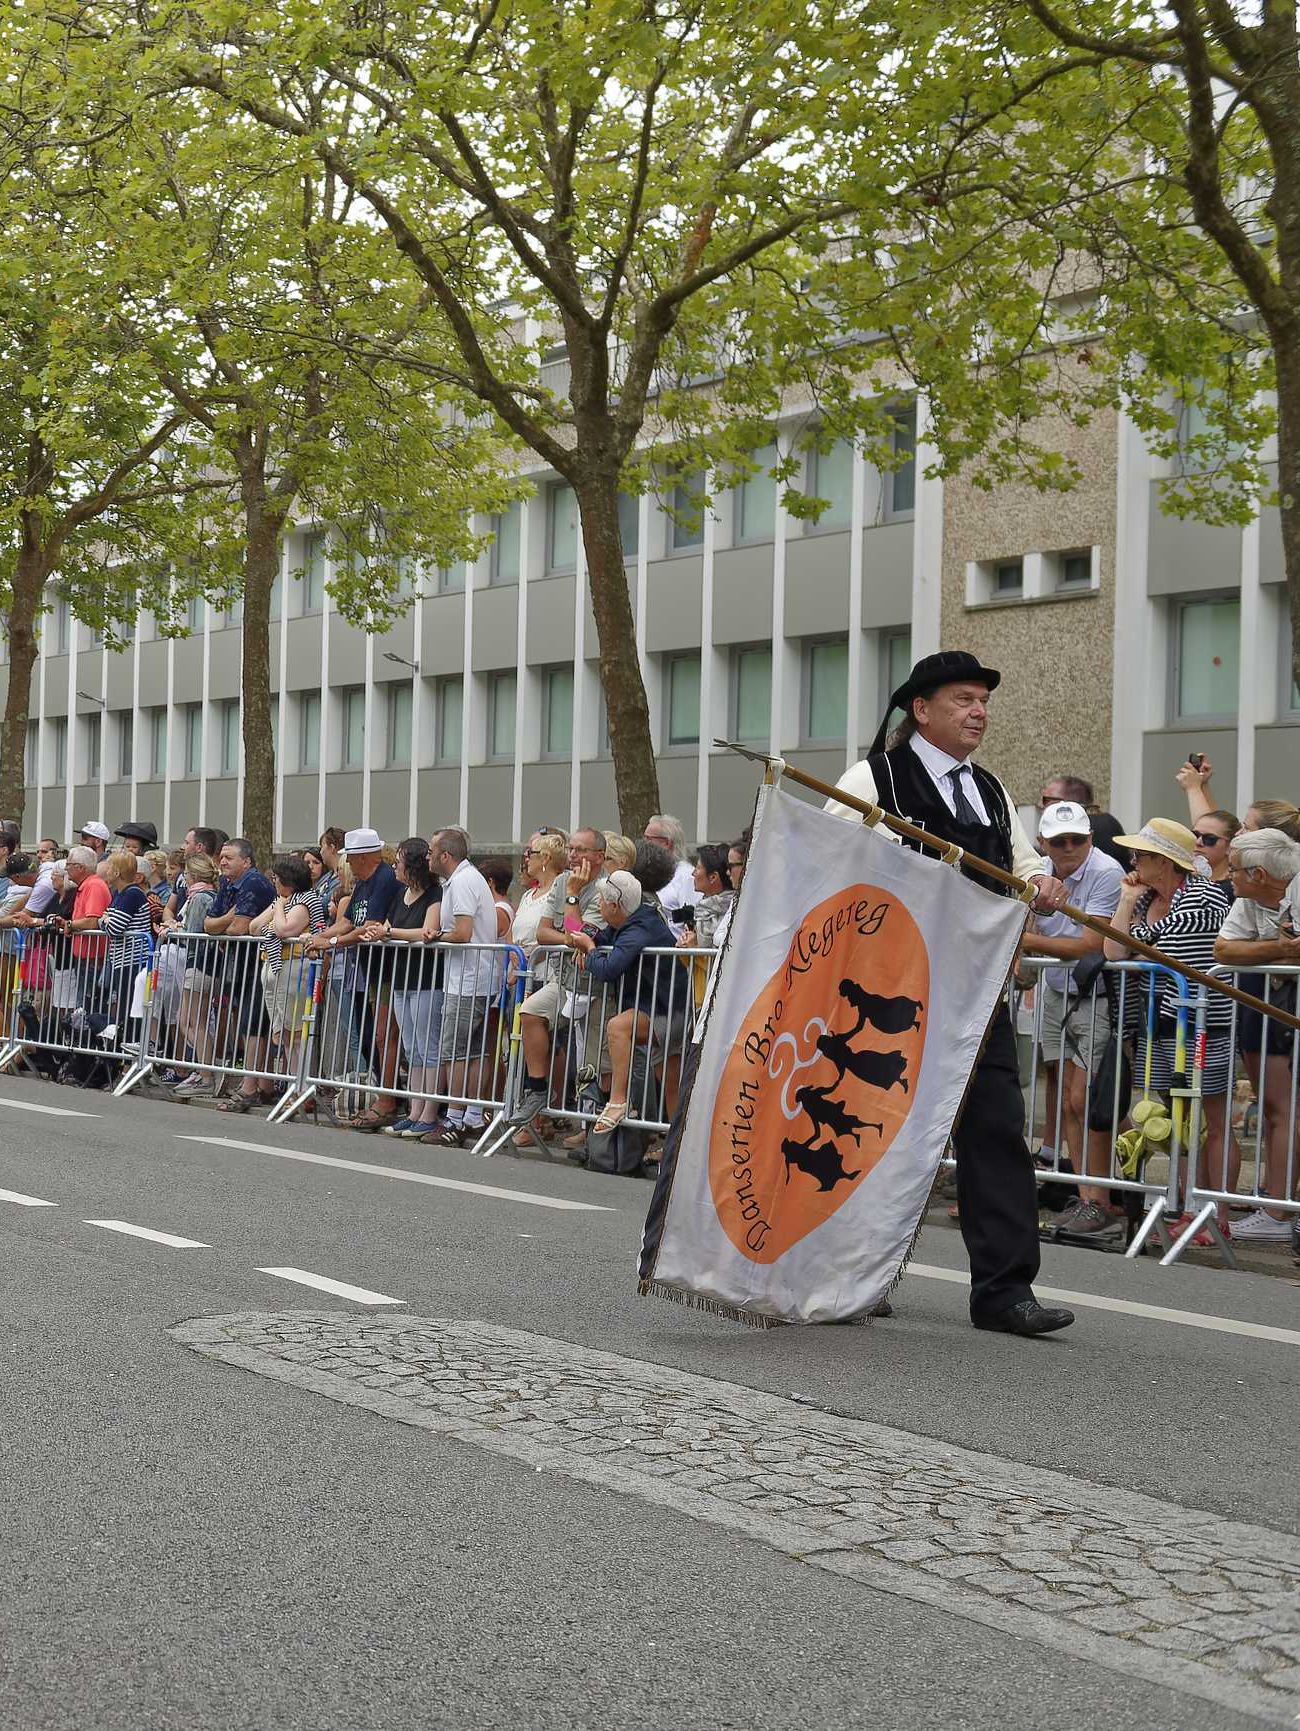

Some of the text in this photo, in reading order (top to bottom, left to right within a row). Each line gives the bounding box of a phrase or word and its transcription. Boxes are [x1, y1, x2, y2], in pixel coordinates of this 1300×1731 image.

[722, 898, 890, 1252] Danserien Bro Klegereg
